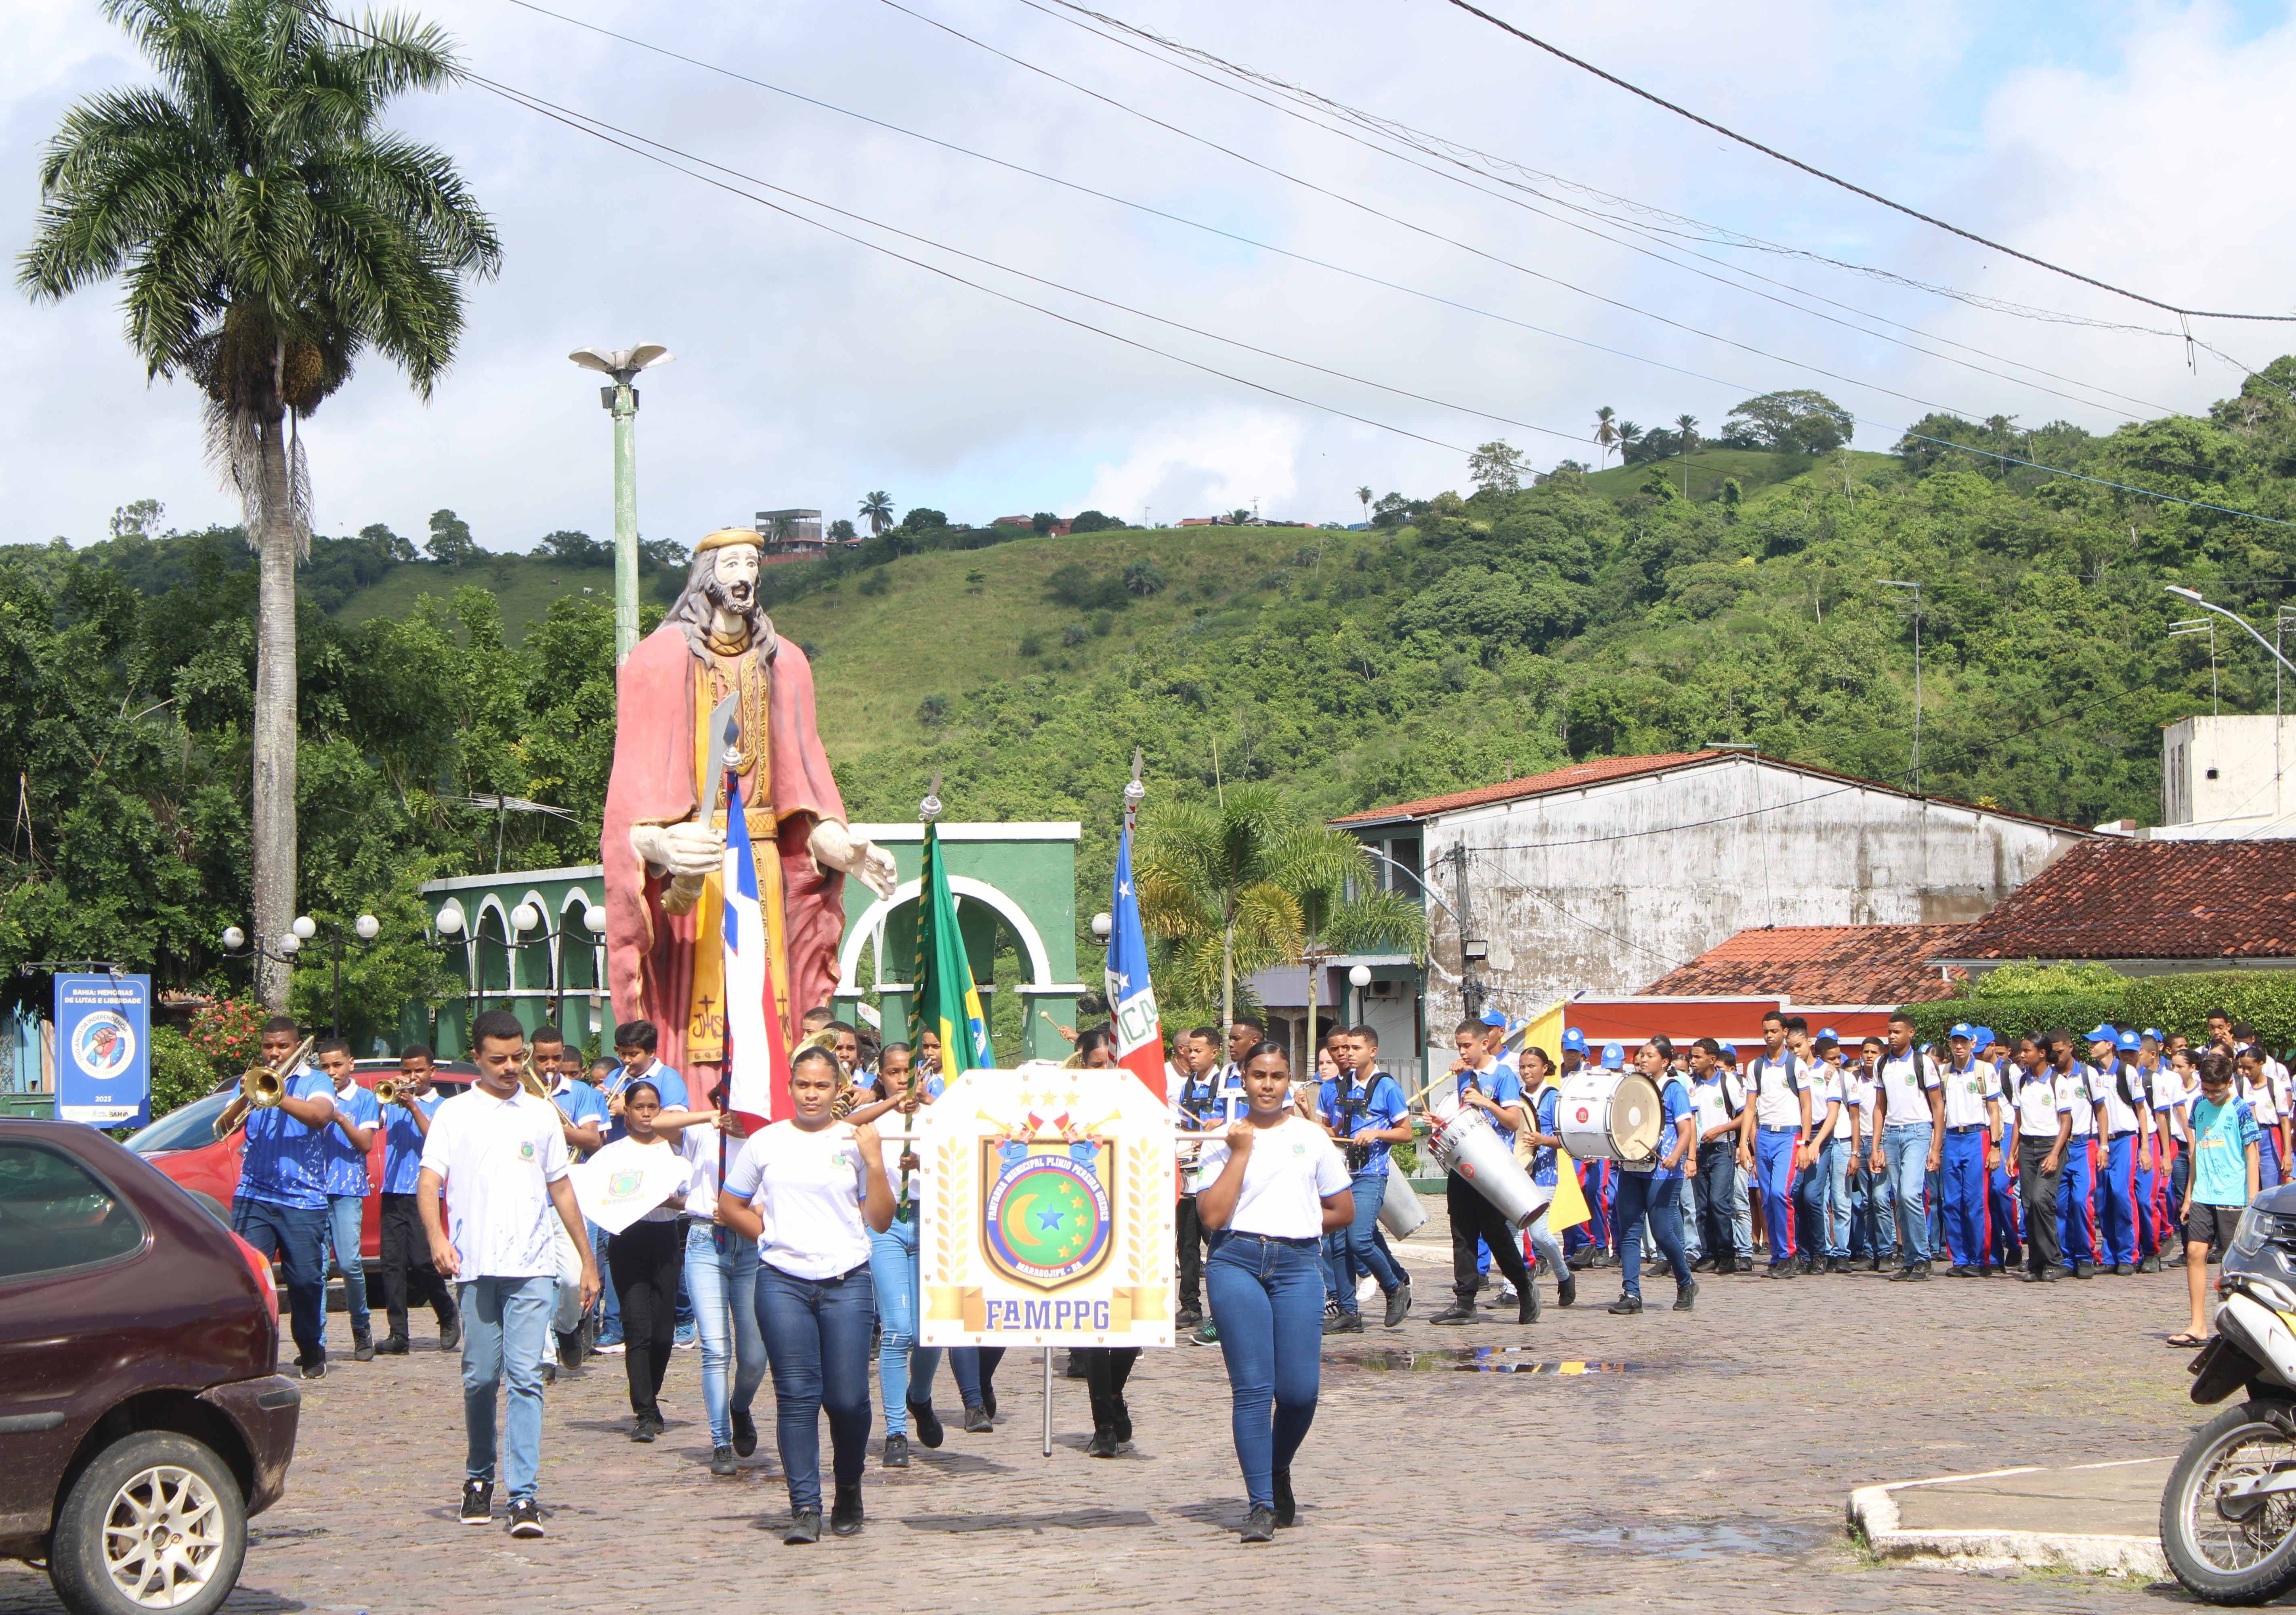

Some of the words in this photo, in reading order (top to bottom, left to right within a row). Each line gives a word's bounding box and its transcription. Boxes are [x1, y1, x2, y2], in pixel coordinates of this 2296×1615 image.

[75, 1030, 83, 1047] ANOS
[80, 1022, 88, 1030] DA
[87, 1015, 128, 1033] INDEPENDÊNCIA
[988, 1181, 1008, 1221] FANFARRA
[1004, 1158, 1045, 1183] MUNICIPAL
[1046, 1157, 1072, 1170] PLÍNIO
[1071, 1164, 1100, 1192] PEREIRA
[1095, 1190, 1109, 1221] GUEDES
[1016, 1261, 1066, 1278] MARAGOJIPE
[1071, 1261, 1083, 1272] BA
[986, 1300, 1109, 1329] FAMPPG
